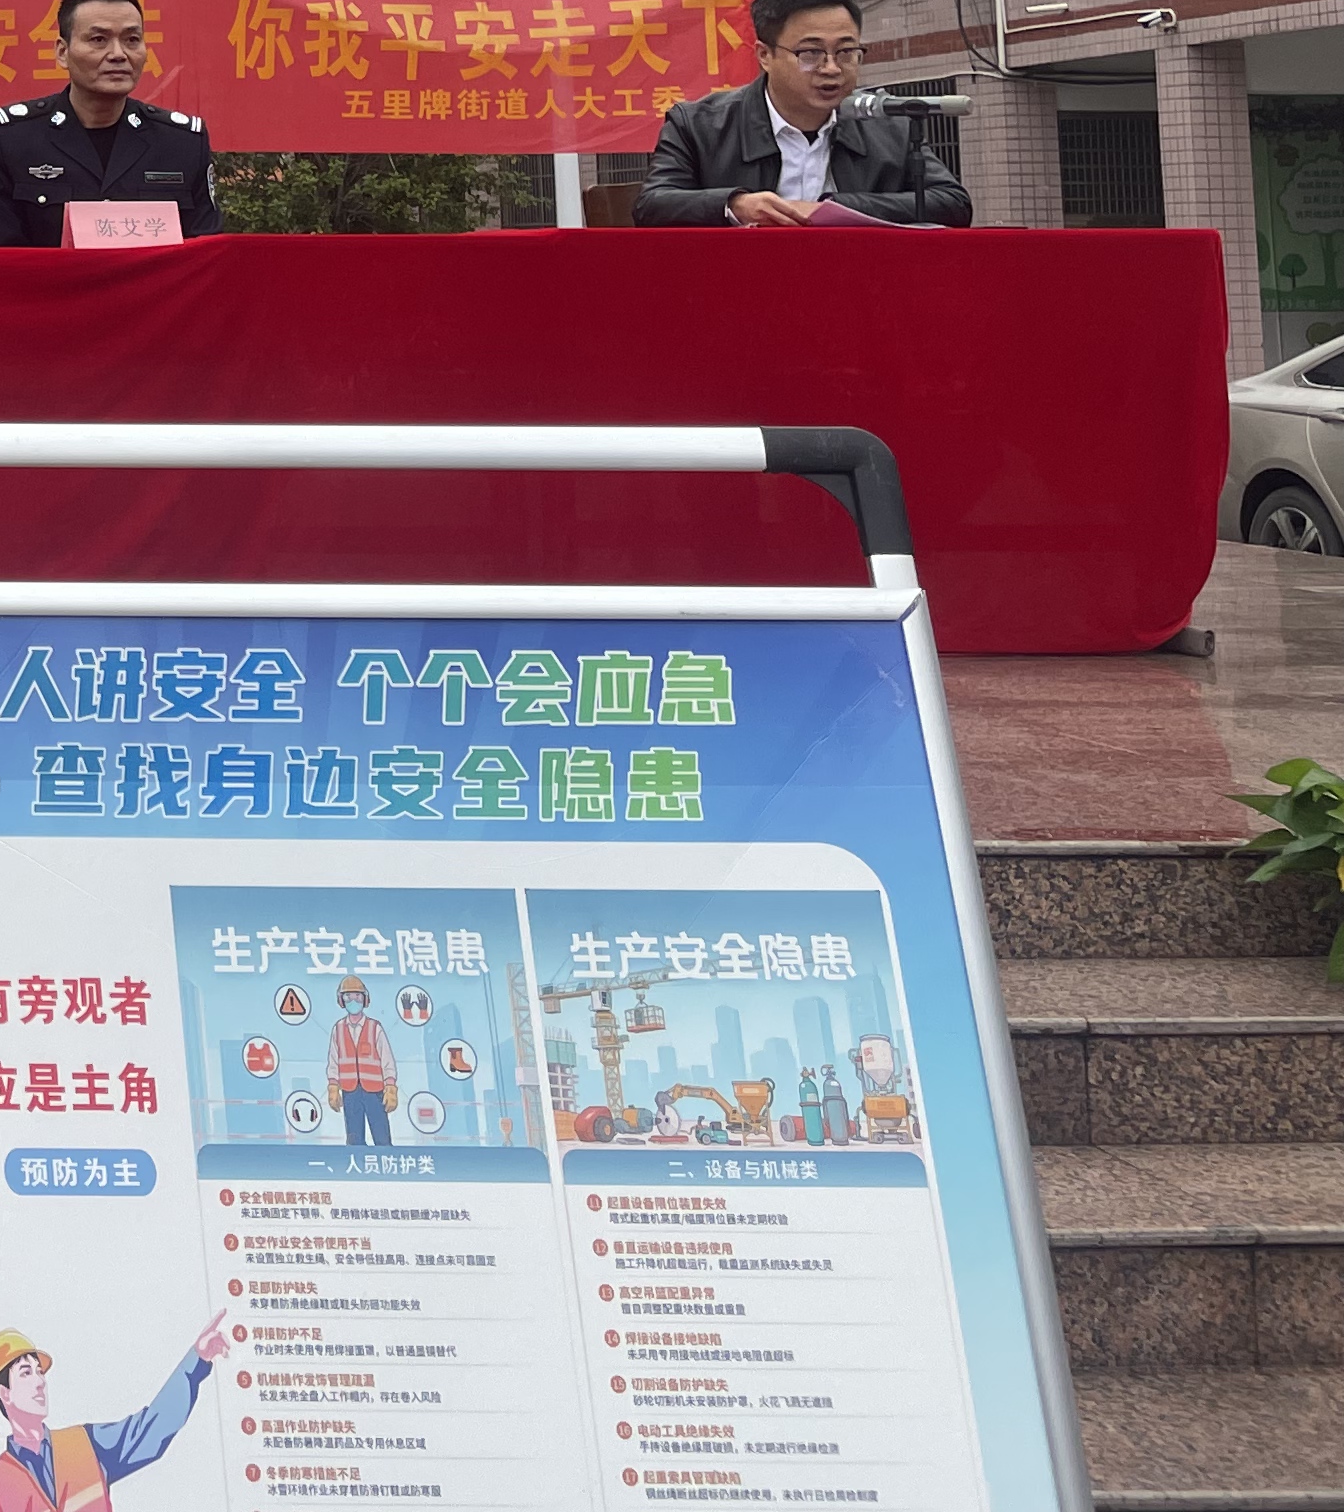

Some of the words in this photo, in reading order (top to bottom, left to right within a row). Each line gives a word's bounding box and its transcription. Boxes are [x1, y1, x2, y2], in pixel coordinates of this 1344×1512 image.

[95, 217, 168, 238] 陈艾学
[336, 648, 737, 728] 个个会应急
[31, 742, 705, 823] 查找身边安全隐患
[210, 924, 491, 978] 生产安全隐患
[569, 930, 858, 983] 生产安全隐患
[20, 1157, 142, 1188] 预防为主
[307, 1154, 437, 1176] 一、人员防护类
[668, 1159, 819, 1182] 二、设备与机械类
